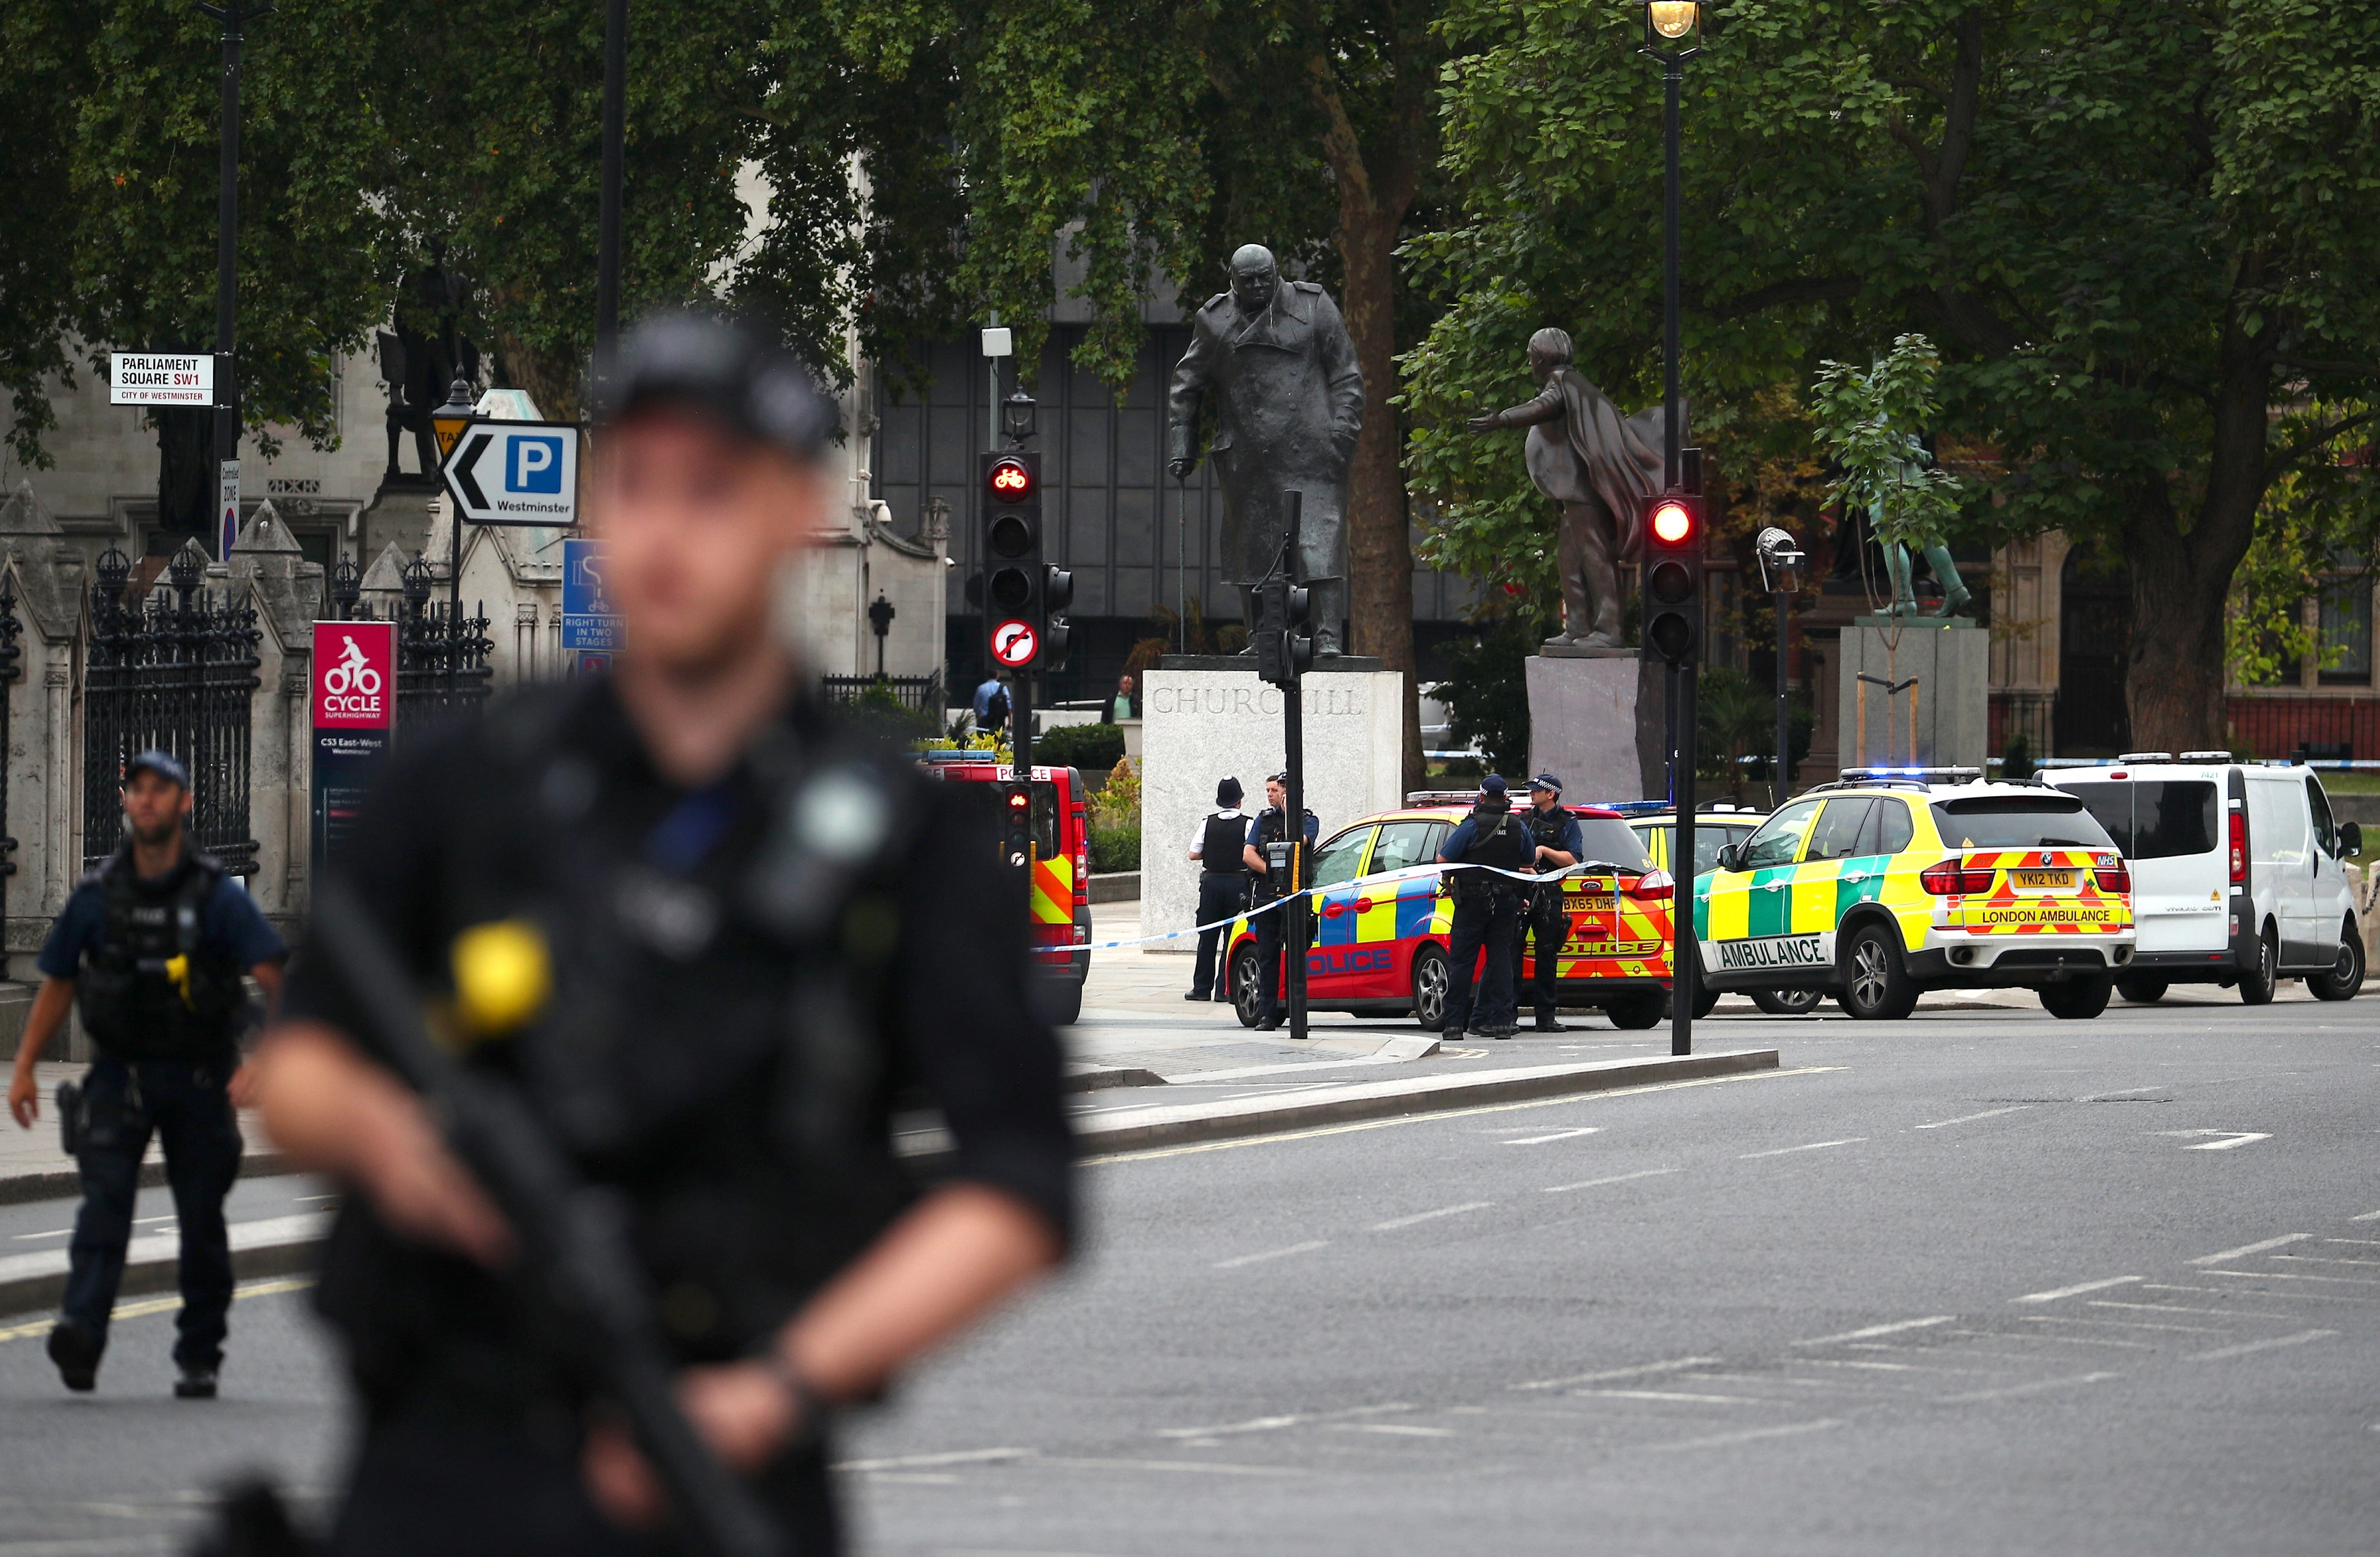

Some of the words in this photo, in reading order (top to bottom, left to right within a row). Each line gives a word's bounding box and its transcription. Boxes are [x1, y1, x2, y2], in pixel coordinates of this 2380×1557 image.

[122, 358, 198, 371] PARLIAMENT
[122, 373, 169, 385] SQUARE
[174, 373, 199, 386] SW1
[152, 392, 203, 400] WESTMINSTER
[439, 432, 458, 442] TA
[517, 440, 552, 487] P
[224, 485, 236, 502] ZONE
[497, 500, 570, 513] Westminster
[566, 618, 594, 627] RIGHT
[598, 619, 624, 628] TURN
[577, 628, 588, 636] IN
[590, 628, 612, 636] TWO
[575, 637, 613, 646] STAGES
[324, 696, 381, 712] CYCLE
[320, 738, 337, 746] CS3
[338, 738, 382, 747] East-West
[2097, 855, 2114, 866] NHS
[2020, 873, 2045, 885] YK12
[2047, 873, 2069, 885] TKD
[1564, 897, 1593, 910] BX65
[1982, 910, 2036, 923] LONDON
[2039, 910, 2110, 922] AMBULANCE
[1720, 939, 1825, 968] AMBULANCE
[1306, 948, 1393, 975] OLICE
